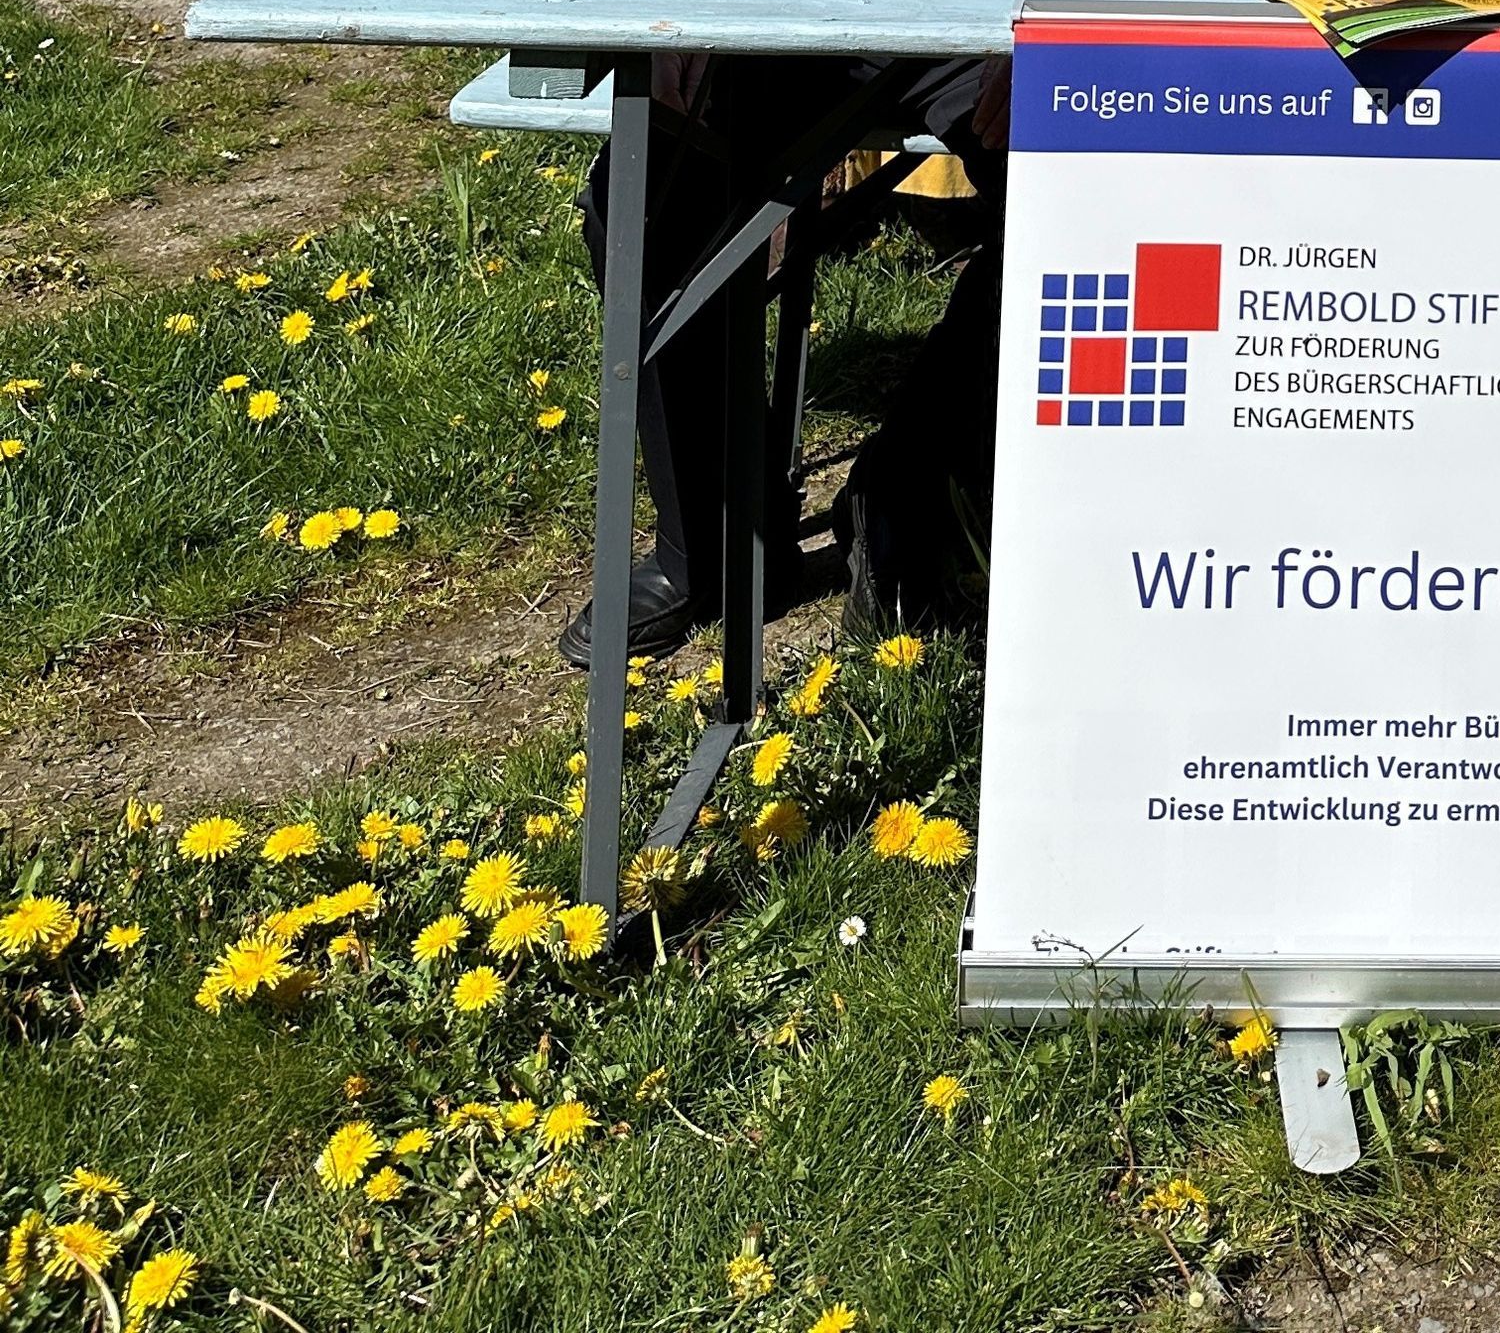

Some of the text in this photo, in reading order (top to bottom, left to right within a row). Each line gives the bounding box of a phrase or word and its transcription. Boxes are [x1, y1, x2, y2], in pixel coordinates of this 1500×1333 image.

[1053, 84, 1154, 120] Folgen
[1163, 86, 1210, 114] Sie
[1219, 94, 1273, 115] uns
[1281, 88, 1334, 116] auf
[1238, 242, 1377, 270] DR. JÜRGEN
[1238, 289, 1416, 323] REMBOLD
[1234, 333, 1441, 360] ZUR FÖRDERUNG
[1234, 370, 1280, 394] DES
[1233, 406, 1415, 431] ENGAGEMENTS
[1131, 548, 1251, 609] Wir
[1287, 714, 1378, 738] Immer
[1385, 714, 1457, 738] mehr
[1183, 754, 1369, 780] ehrenamtlich
[1148, 796, 1224, 821] Diese
[1233, 796, 1401, 827] Entwicklung
[1408, 803, 1438, 821] zu
